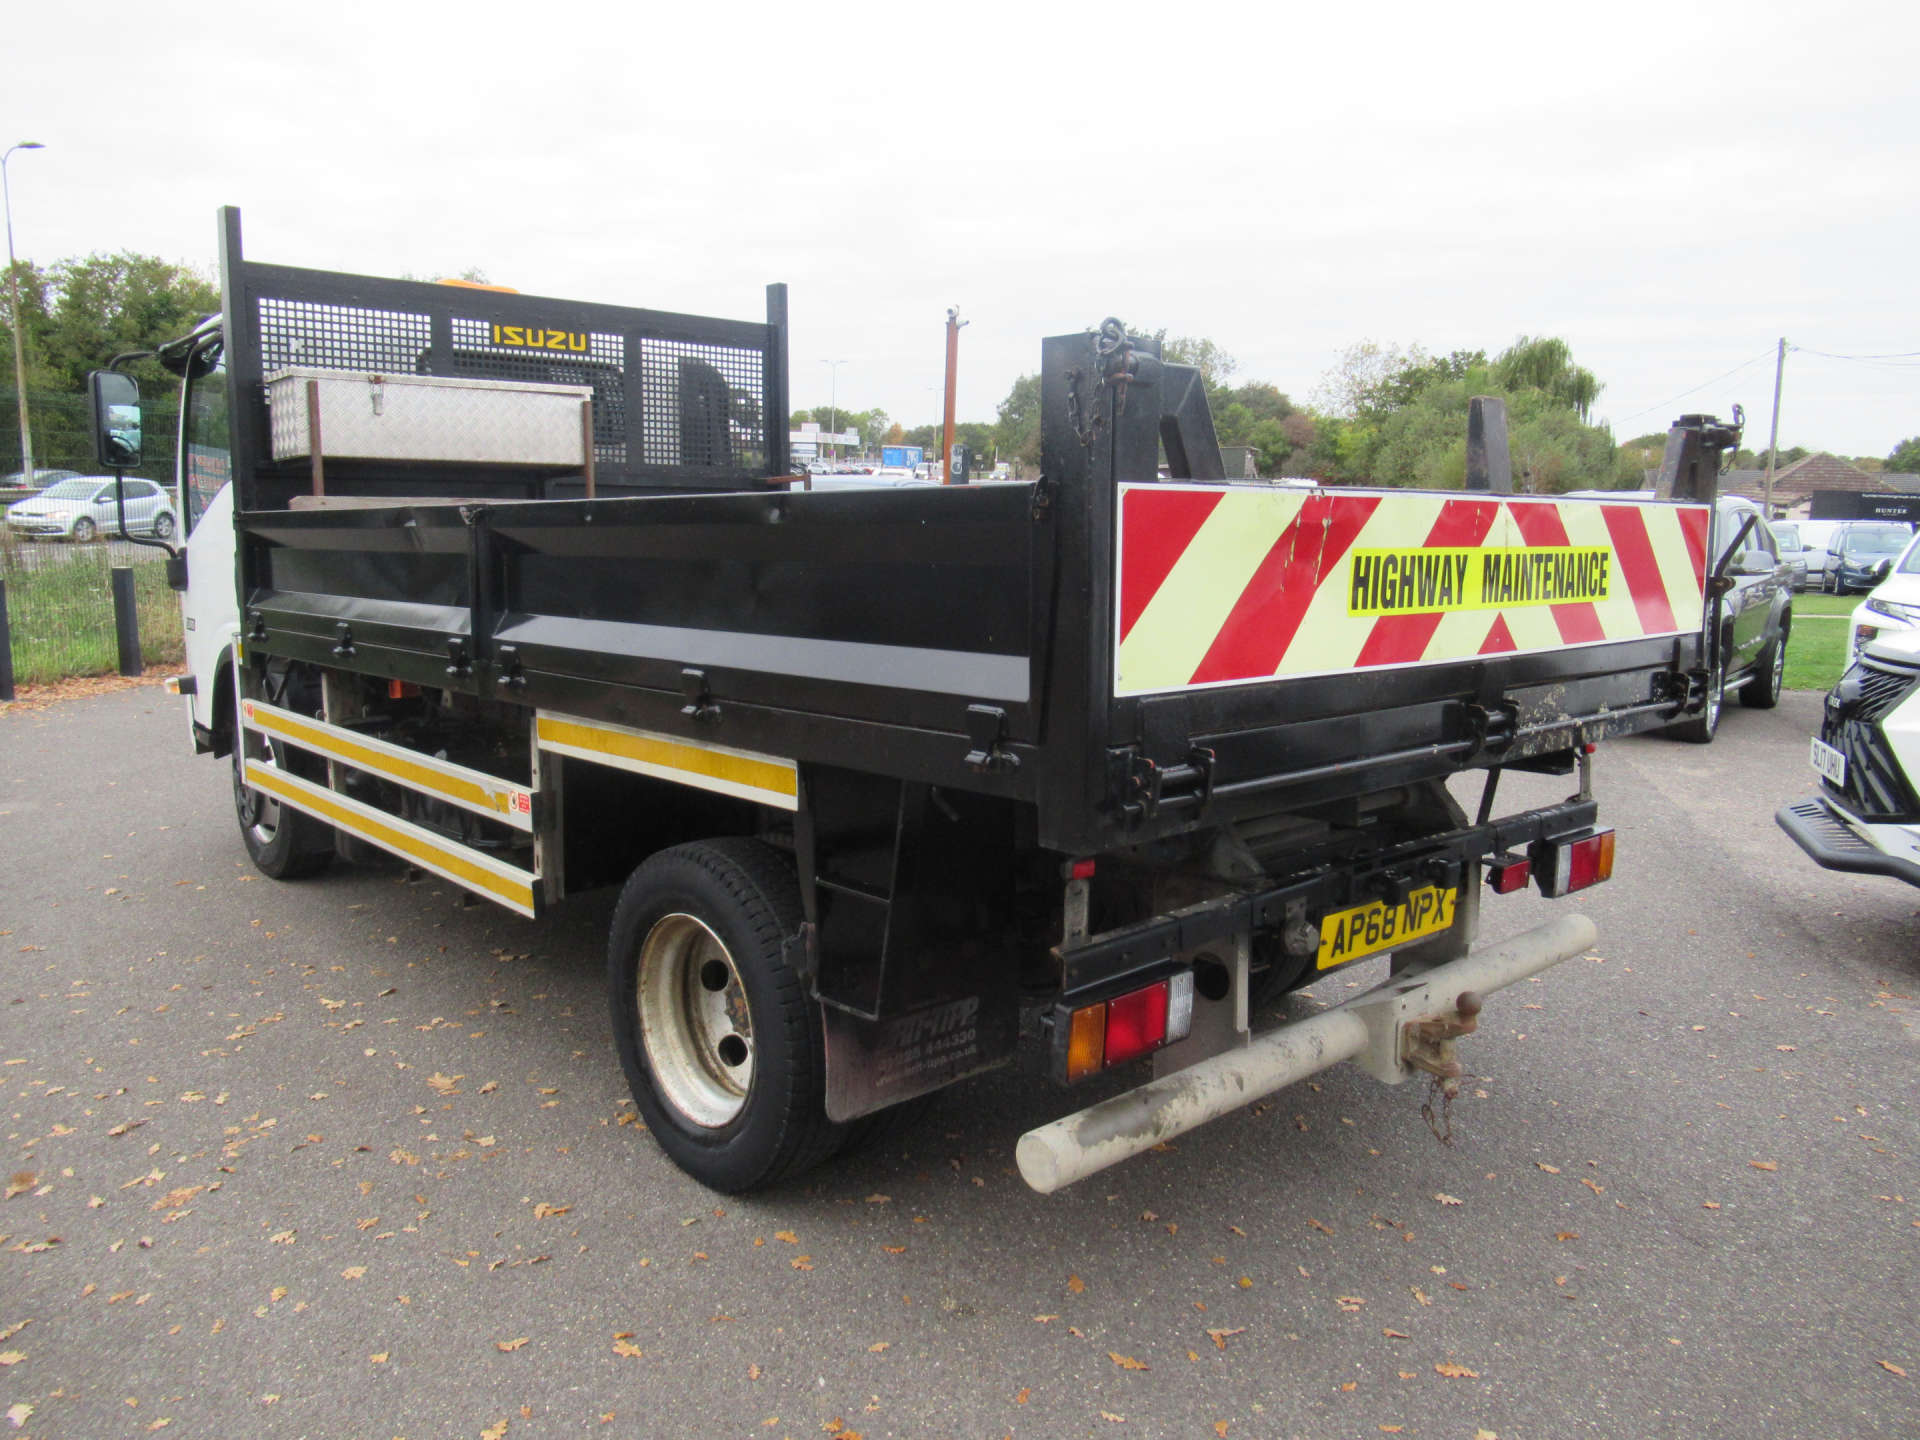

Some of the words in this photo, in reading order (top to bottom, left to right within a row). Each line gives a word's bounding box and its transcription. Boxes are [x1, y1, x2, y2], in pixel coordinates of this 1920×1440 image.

[493, 324, 587, 352] ISUZU
[1351, 554, 1468, 611] HIGHWAY
[1481, 551, 1609, 604] MAINTENANCE
[1331, 904, 1398, 959] AP68
[1402, 889, 1448, 935] NPX
